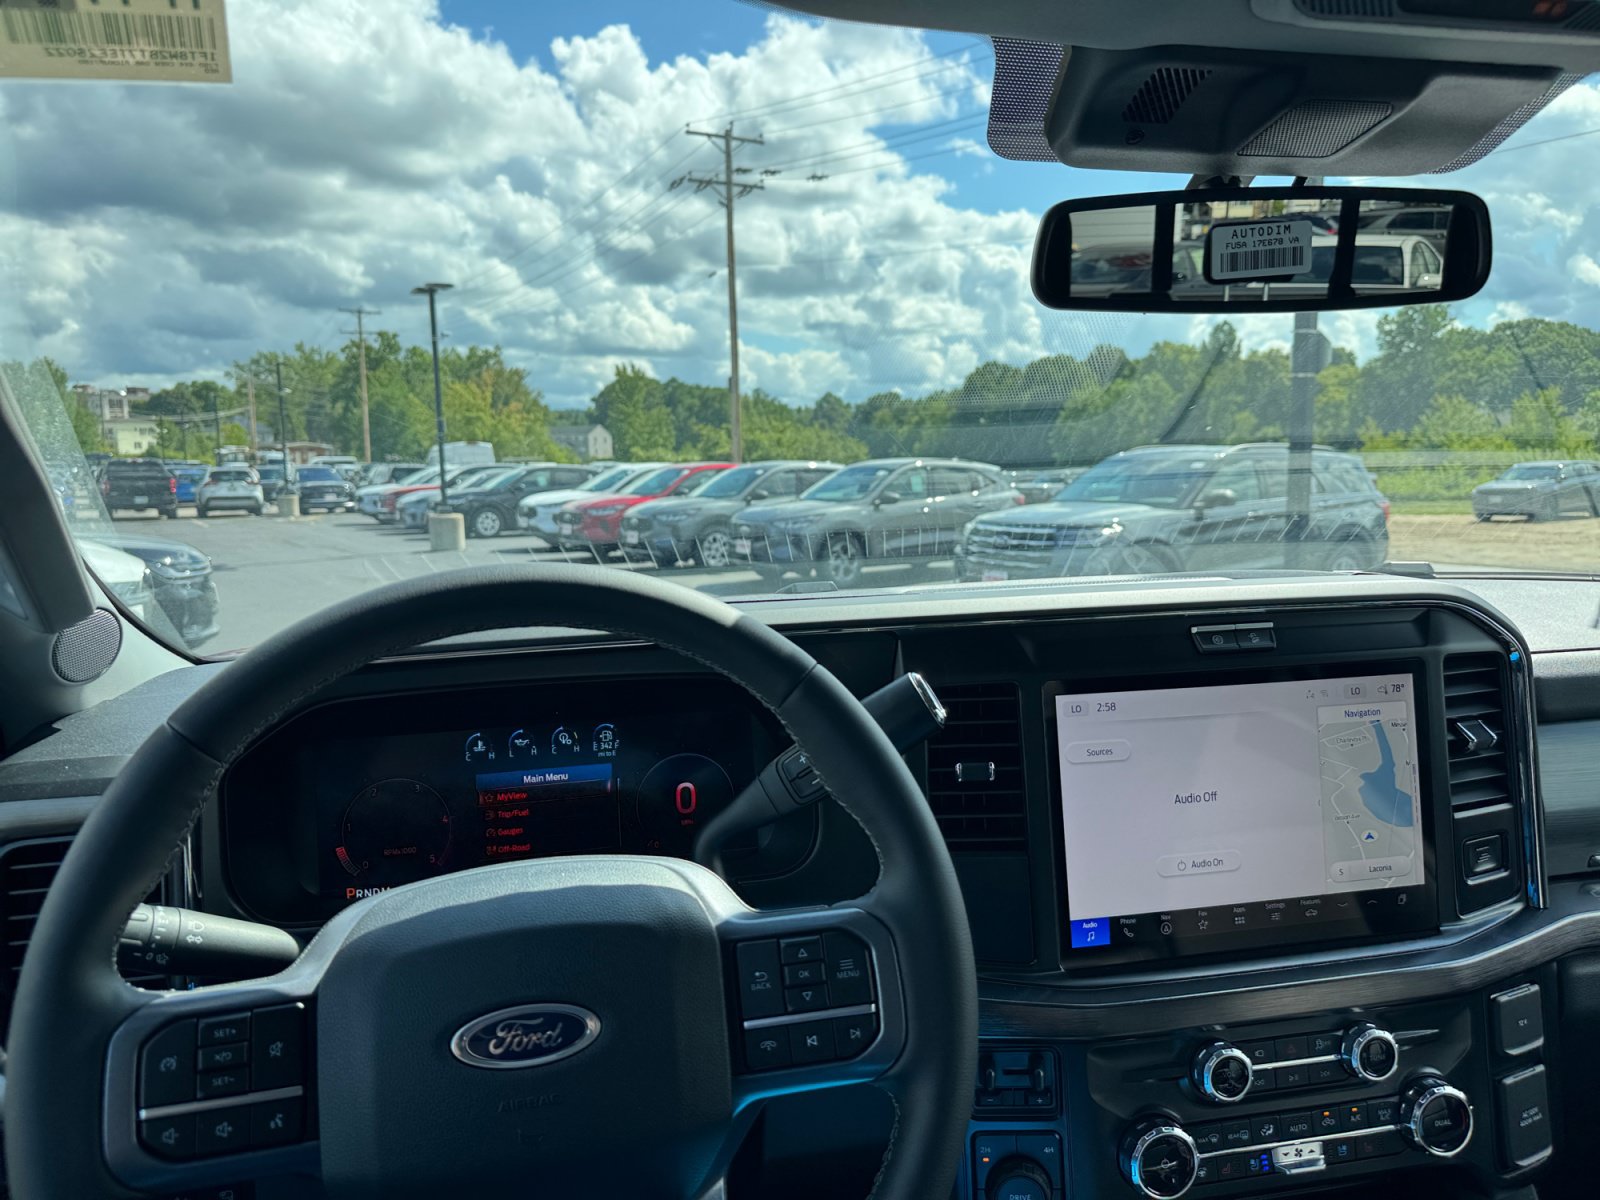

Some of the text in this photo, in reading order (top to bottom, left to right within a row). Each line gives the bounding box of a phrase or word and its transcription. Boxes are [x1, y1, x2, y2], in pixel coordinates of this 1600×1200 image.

[1231, 224, 1292, 240] AUTODIM
[1252, 239, 1284, 248] 17E678
[1288, 237, 1300, 245] VA
[1350, 687, 1361, 696] LO
[1071, 702, 1117, 714] LO 2:58
[1344, 708, 1381, 719] Navigation
[600, 741, 613, 750] 342
[1086, 748, 1114, 757] Sources
[523, 772, 569, 784] Main Menu
[497, 792, 528, 801] MyView
[675, 782, 697, 814] 0
[1174, 790, 1218, 805] Audio Off
[497, 808, 529, 818] Trip/Fuel
[497, 827, 523, 836] Gauges
[497, 843, 531, 853] Off-Road
[1191, 858, 1224, 869] Audio On
[1338, 868, 1345, 876] S
[1368, 864, 1393, 873] Laconia
[1264, 901, 1286, 910] Settings
[1082, 921, 1098, 929] Audio
[1120, 917, 1136, 925] Phone
[799, 970, 810, 978] OK
[836, 970, 860, 979] MENU
[751, 982, 772, 991] BACK
[487, 1017, 563, 1055] Ford
[1434, 1119, 1453, 1127] DUAL
[1289, 1123, 1308, 1133] AUTO
